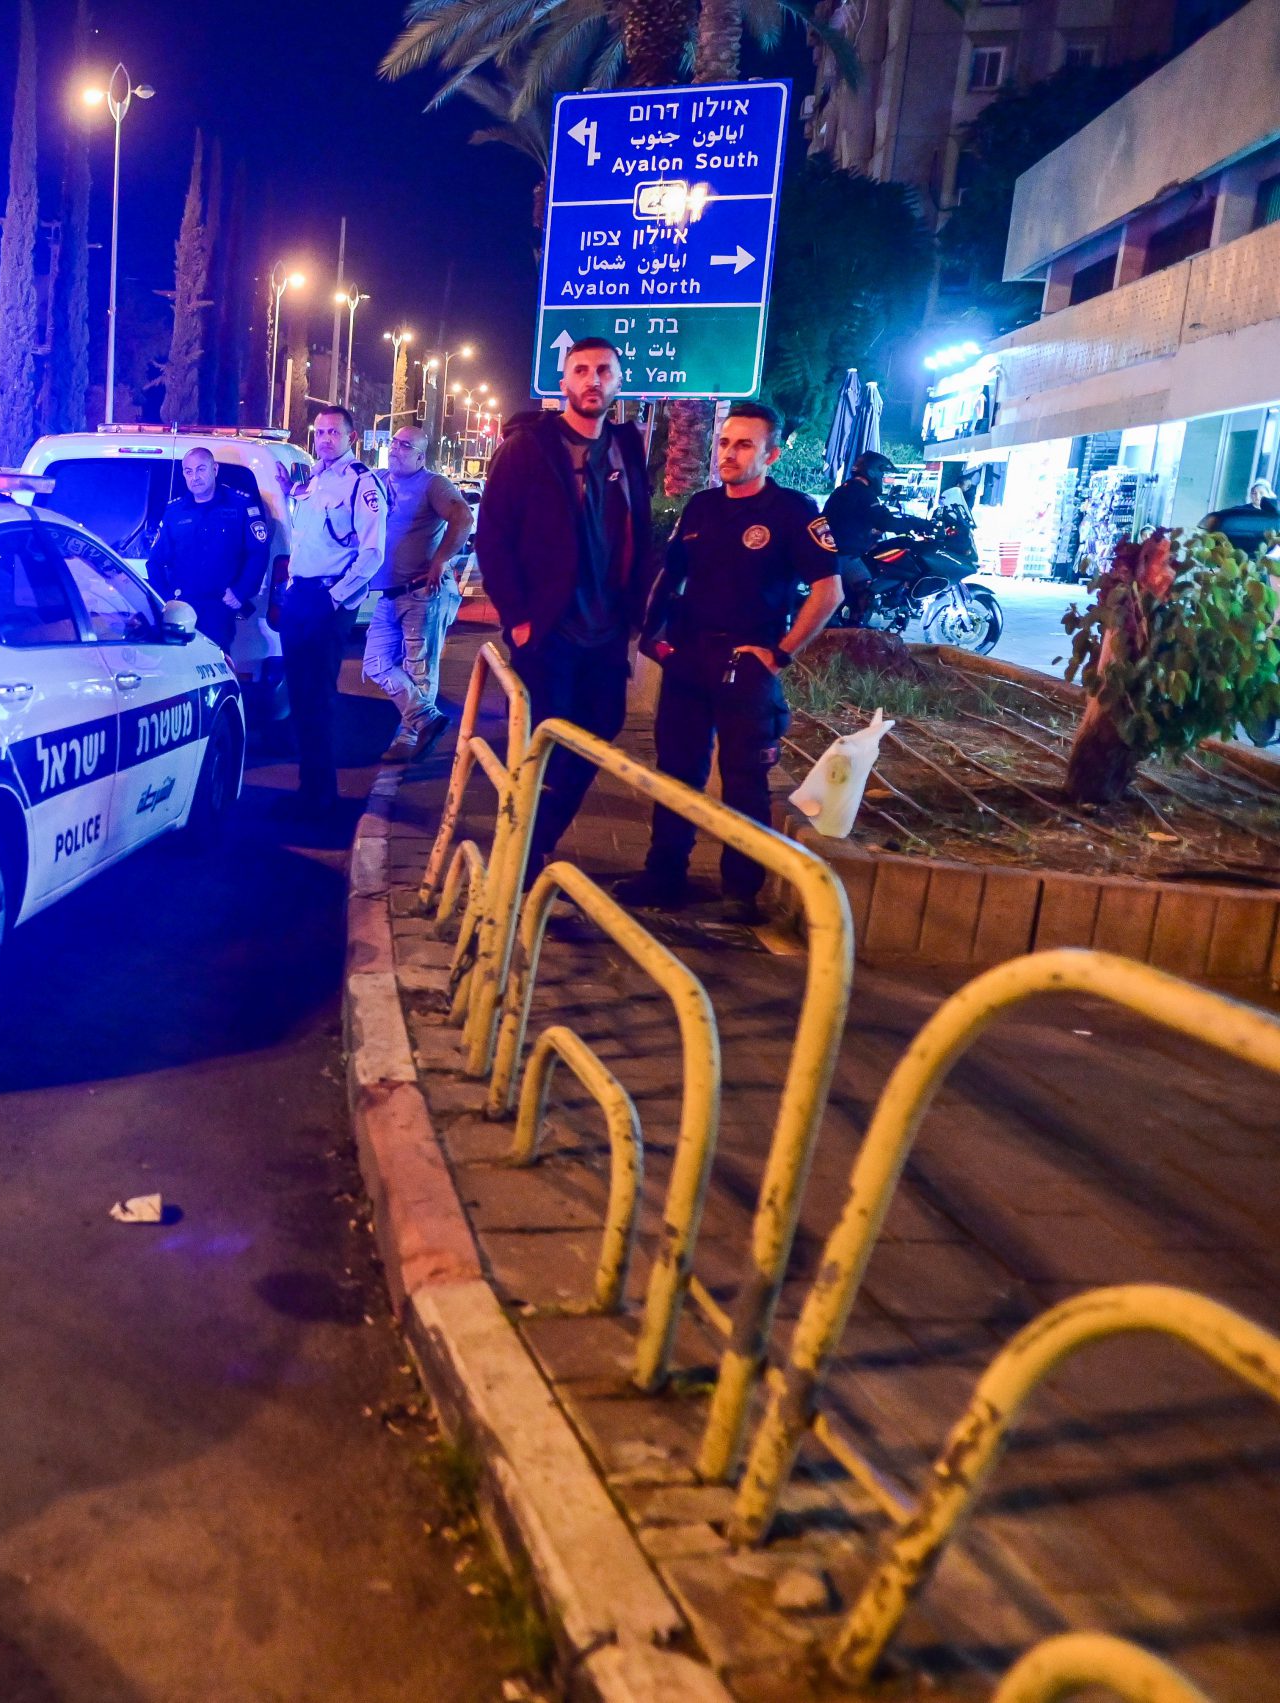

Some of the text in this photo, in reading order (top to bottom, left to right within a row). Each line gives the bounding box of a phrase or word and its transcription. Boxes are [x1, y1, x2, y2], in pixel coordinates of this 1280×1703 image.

[629, 97, 750, 122] איילון דרום
[630, 125, 744, 151] ايالون جنوب
[612, 152, 759, 176] Ayalon South
[580, 225, 689, 251] איילון צפון
[578, 254, 687, 276] ايالون شمال
[561, 279, 701, 298] Ayalon North
[615, 318, 679, 334] בת ים
[648, 341, 677, 361] بات
[646, 367, 687, 383] Yam
[35, 700, 192, 794] משטרת ישראל
[54, 814, 102, 863] POLICE
